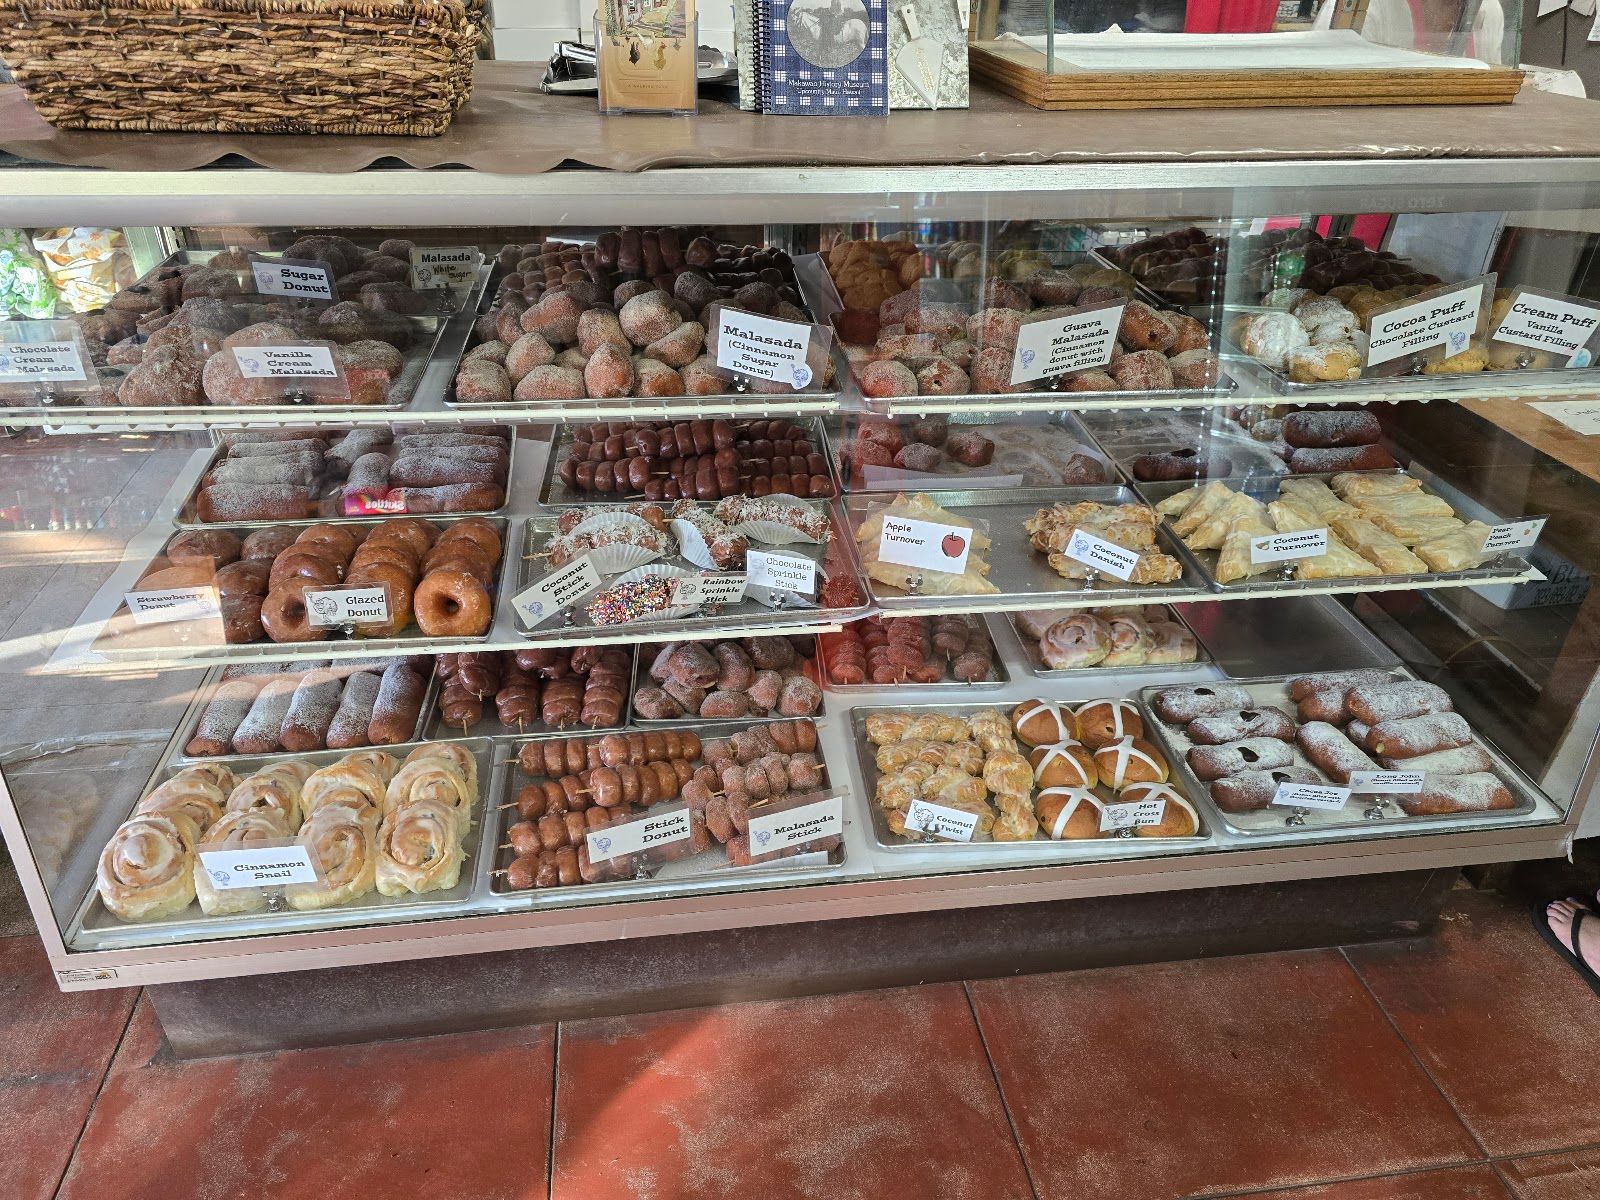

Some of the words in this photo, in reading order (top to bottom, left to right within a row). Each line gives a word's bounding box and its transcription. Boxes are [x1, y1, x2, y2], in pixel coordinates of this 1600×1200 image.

[819, 80, 843, 89] History
[421, 253, 471, 263] Malasada
[281, 268, 324, 281] Sugar
[433, 264, 456, 275] White
[282, 281, 329, 293] Donut
[1382, 315, 1426, 334] Cocoa
[1430, 300, 1466, 319] Puff
[1512, 303, 1558, 320] Cream
[1560, 313, 1596, 328] Puff
[1063, 320, 1101, 333] Guava
[1370, 327, 1425, 349] Chocolate
[1428, 311, 1475, 330] Custard
[1527, 321, 1563, 335] Vanilla
[723, 325, 803, 350] Malasada
[1051, 328, 1109, 346] Malasada
[1402, 333, 1440, 348] Filling
[1499, 326, 1542, 341] Custard
[1543, 335, 1578, 350] Filling
[10, 345, 71, 354] Chocolate
[728, 340, 795, 360] (Cinnamon
[1051, 340, 1105, 356] (Cinnamon
[14, 356, 55, 364] Cream
[742, 353, 779, 368] Sugar
[1049, 354, 1078, 364] donut
[1081, 347, 1104, 358] with
[732, 360, 774, 378] Donut)
[1042, 364, 1071, 375] guava
[1073, 354, 1106, 367] filling)
[886, 521, 912, 533] Apple
[885, 532, 925, 546] Turnover
[1273, 533, 1320, 545] Coconut
[1273, 541, 1325, 552] Turnover
[1090, 550, 1125, 570] Danish
[1093, 544, 1135, 565] Coconut
[766, 557, 812, 571] Chocolate
[541, 562, 588, 593] Coconut
[767, 567, 807, 581] Sprinkle
[553, 574, 585, 597] Stick
[700, 586, 740, 595] Sprinkle
[775, 579, 798, 590] Stick
[136, 593, 204, 604] Strawberry
[345, 594, 385, 605] Glazed
[556, 581, 591, 605] Donut
[140, 602, 176, 611] Donut
[347, 607, 382, 617] Donut
[644, 816, 685, 833] Stick
[774, 815, 835, 835] Malasada
[936, 815, 974, 830] Coconut
[642, 825, 689, 844] Donut
[787, 826, 822, 841] Stick
[940, 824, 964, 836] Twist
[234, 861, 305, 872] Cinnamon
[254, 869, 292, 880] Snail
